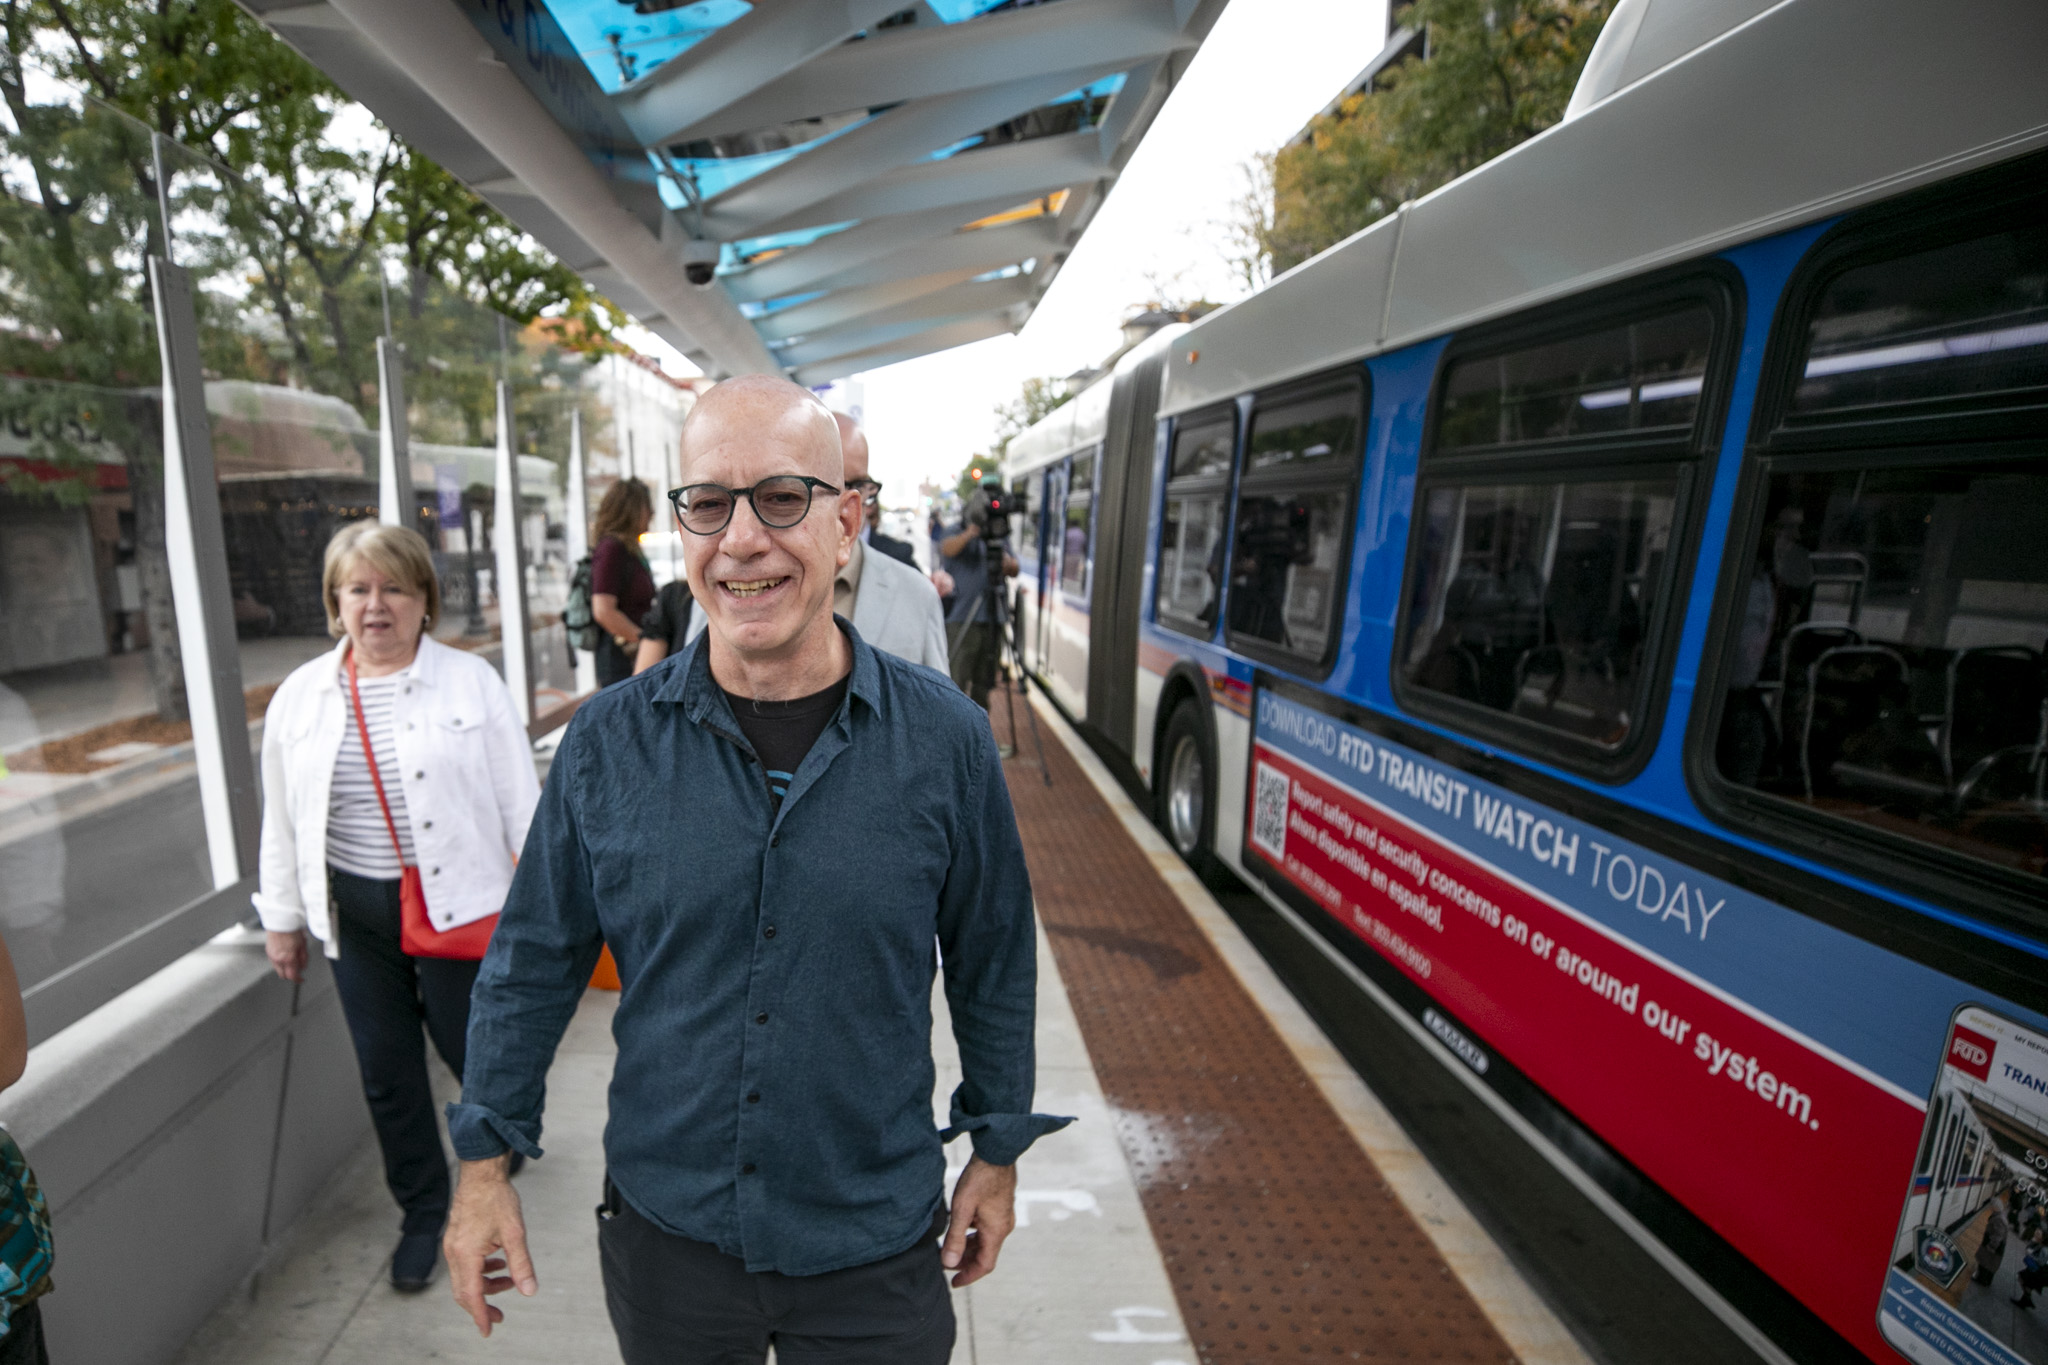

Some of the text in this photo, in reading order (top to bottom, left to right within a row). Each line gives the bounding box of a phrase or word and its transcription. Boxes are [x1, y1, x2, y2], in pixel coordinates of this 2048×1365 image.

[1261, 697, 1725, 940] DOWNLOAD RTD TRANSIT WATCH TODAY
[1370, 867, 1388, 893] en
[1292, 780, 1322, 817] Report
[1322, 802, 1355, 840] safety
[1353, 821, 1378, 850] and
[1376, 836, 1430, 886] security
[1429, 868, 1501, 928] concerns
[1502, 914, 1528, 946] on
[1530, 931, 1555, 960] or
[1555, 946, 1641, 1014] around
[1642, 1000, 1691, 1045] our
[1694, 1032, 1820, 1131] system.
[1952, 1037, 1988, 1066] RTD
